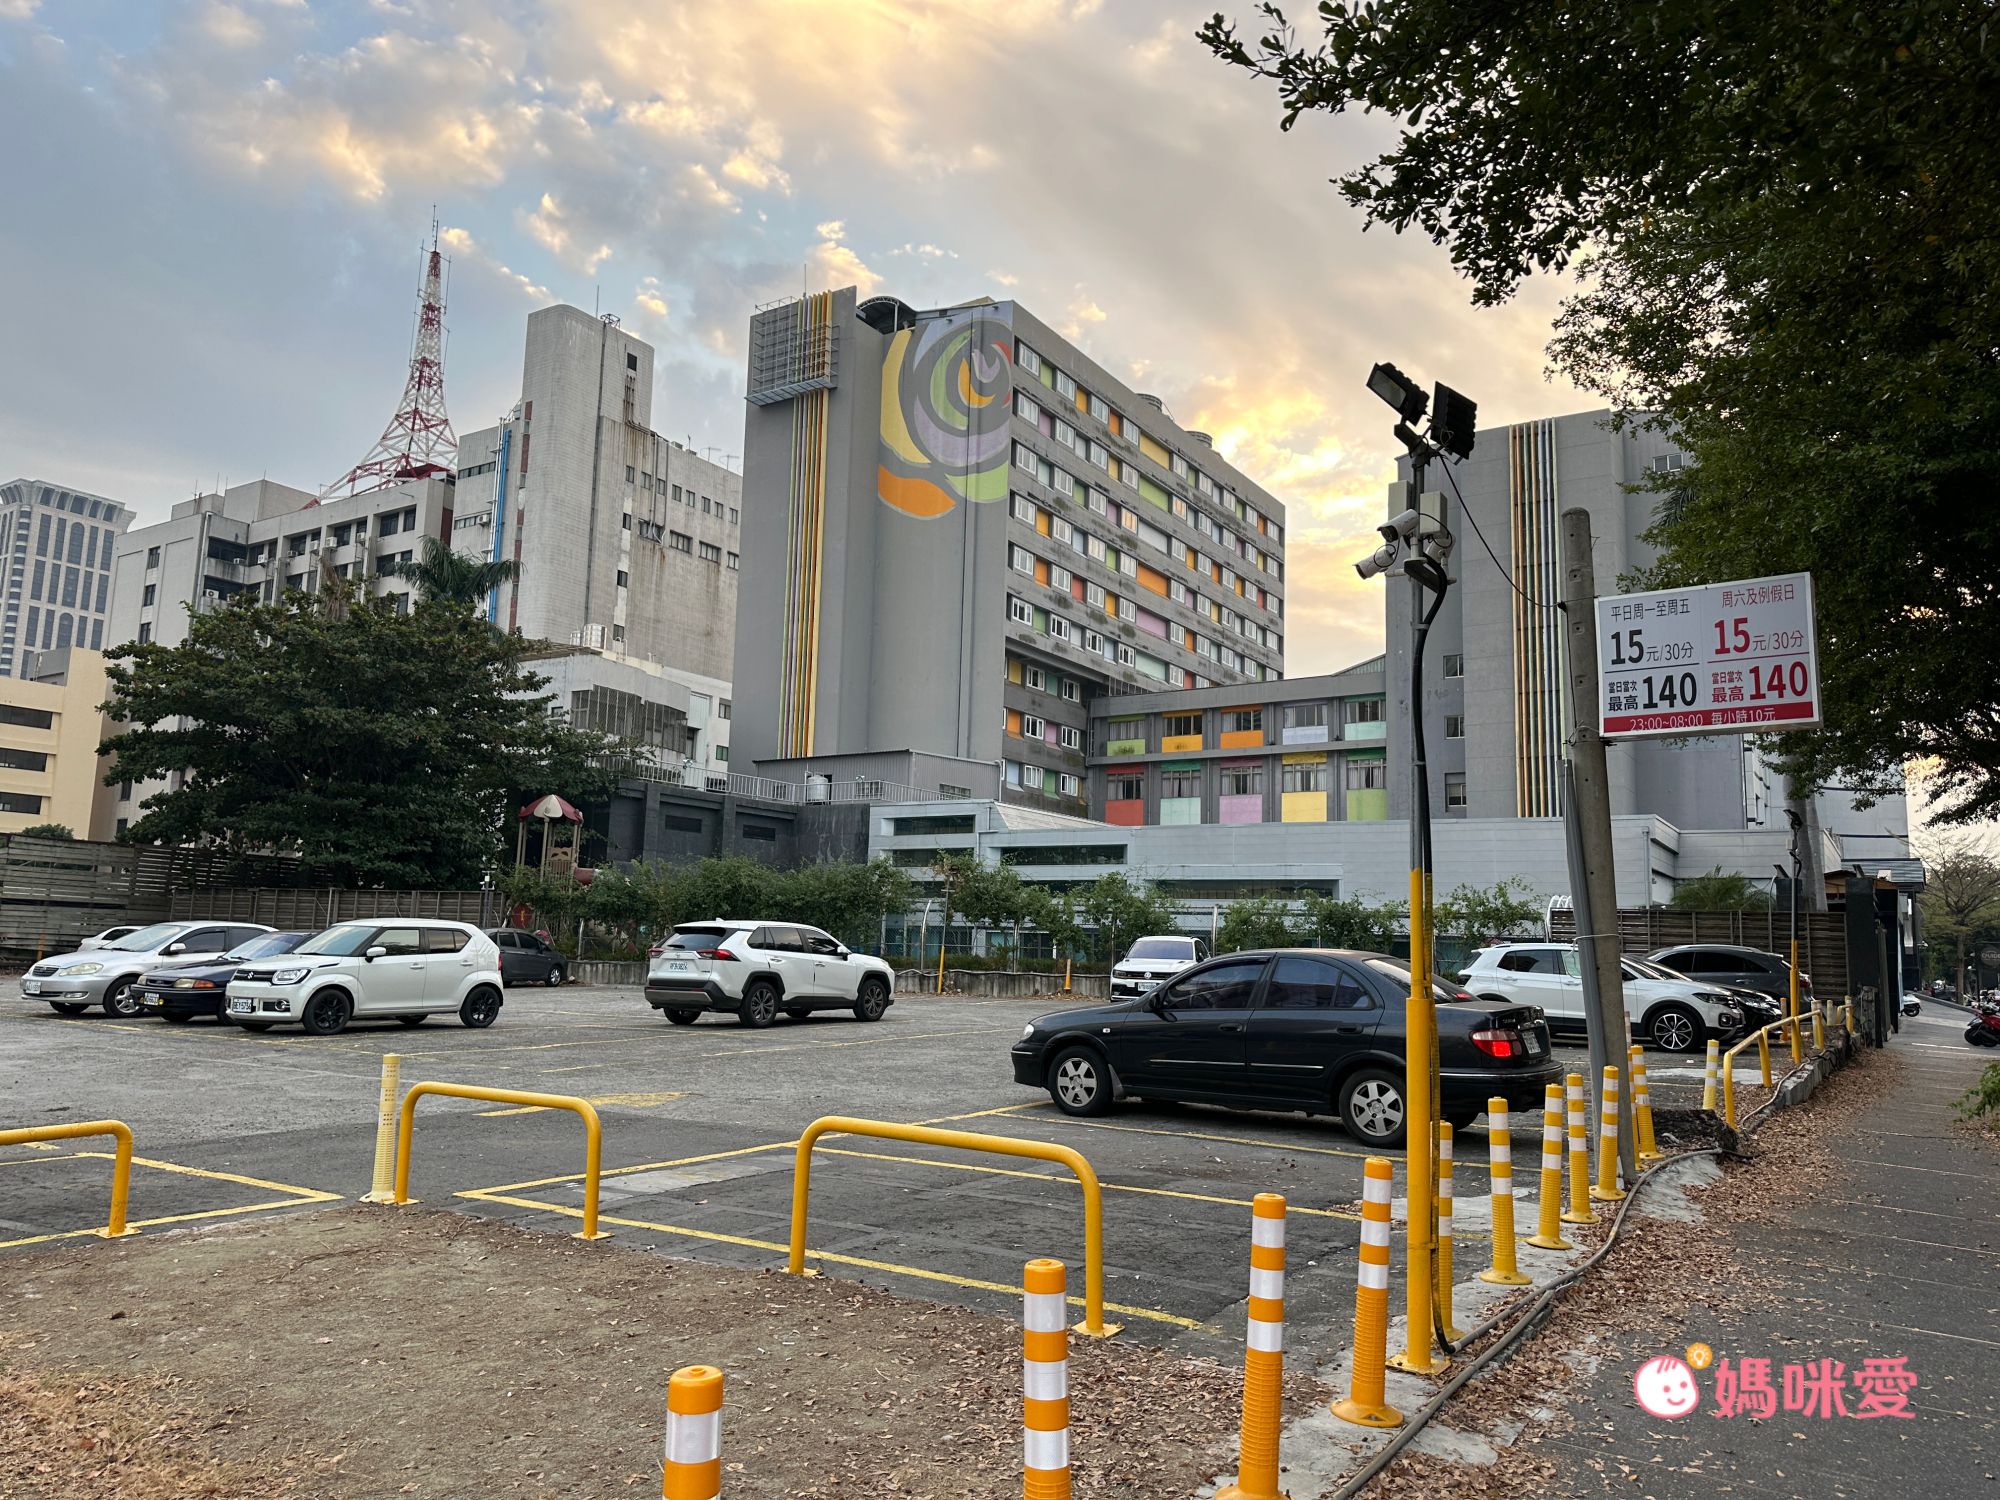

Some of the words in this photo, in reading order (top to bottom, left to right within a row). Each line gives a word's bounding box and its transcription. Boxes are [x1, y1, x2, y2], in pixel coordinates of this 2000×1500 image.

[1722, 584, 1794, 608] 周六及例假日
[1611, 599, 1691, 622] 平日周一至周五
[1608, 680, 1637, 694] 當日當次
[1712, 670, 1743, 684] 當日當次
[1712, 686, 1744, 703] 最高
[1749, 661, 1808, 700] 140
[1608, 695, 1638, 711] 最高
[1643, 672, 1697, 709] 140
